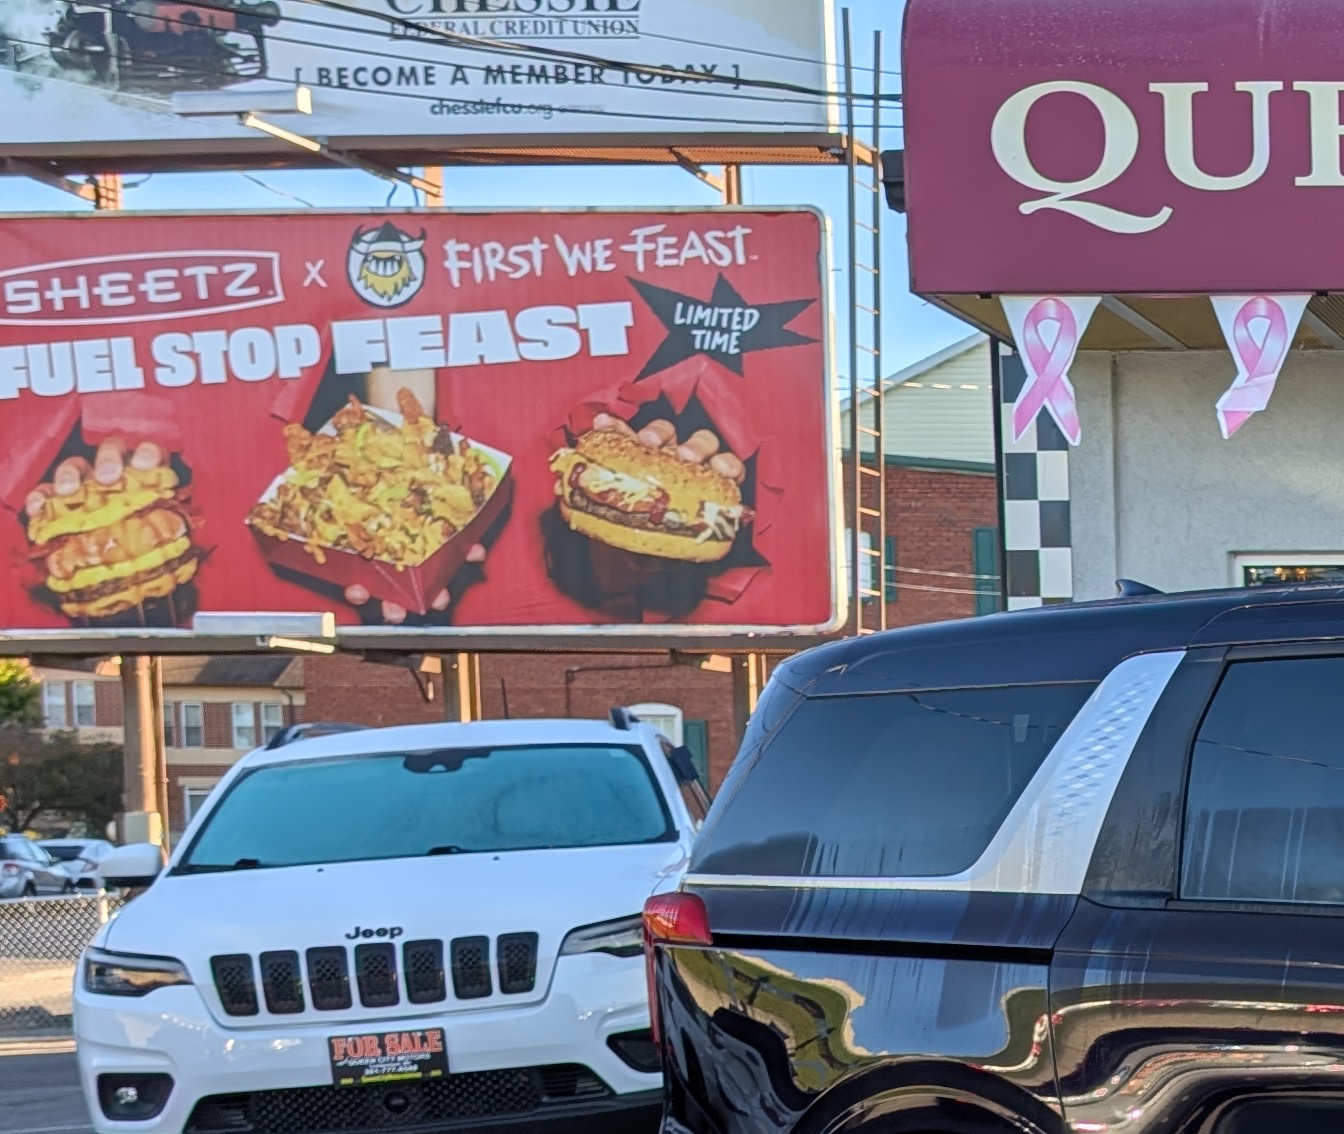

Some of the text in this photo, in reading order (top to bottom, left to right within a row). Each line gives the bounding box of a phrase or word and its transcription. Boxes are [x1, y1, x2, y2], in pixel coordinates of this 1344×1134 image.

[489, 20, 566, 36] CREDIT
[573, 20, 639, 35] UNION
[317, 66, 436, 87] BECOME
[450, 65, 469, 85] A
[484, 64, 606, 85] MEMBER
[5, 263, 260, 314] SHEETZ
[443, 237, 548, 287] FIRST
[554, 234, 615, 276] WE
[620, 224, 752, 272] FEAST
[674, 302, 760, 332] LIMITED
[0, 301, 634, 400] FUEL STOP FEAST
[691, 328, 741, 355] TIME
[345, 926, 404, 939] Jeep
[331, 1029, 443, 1060] FOR SALE
